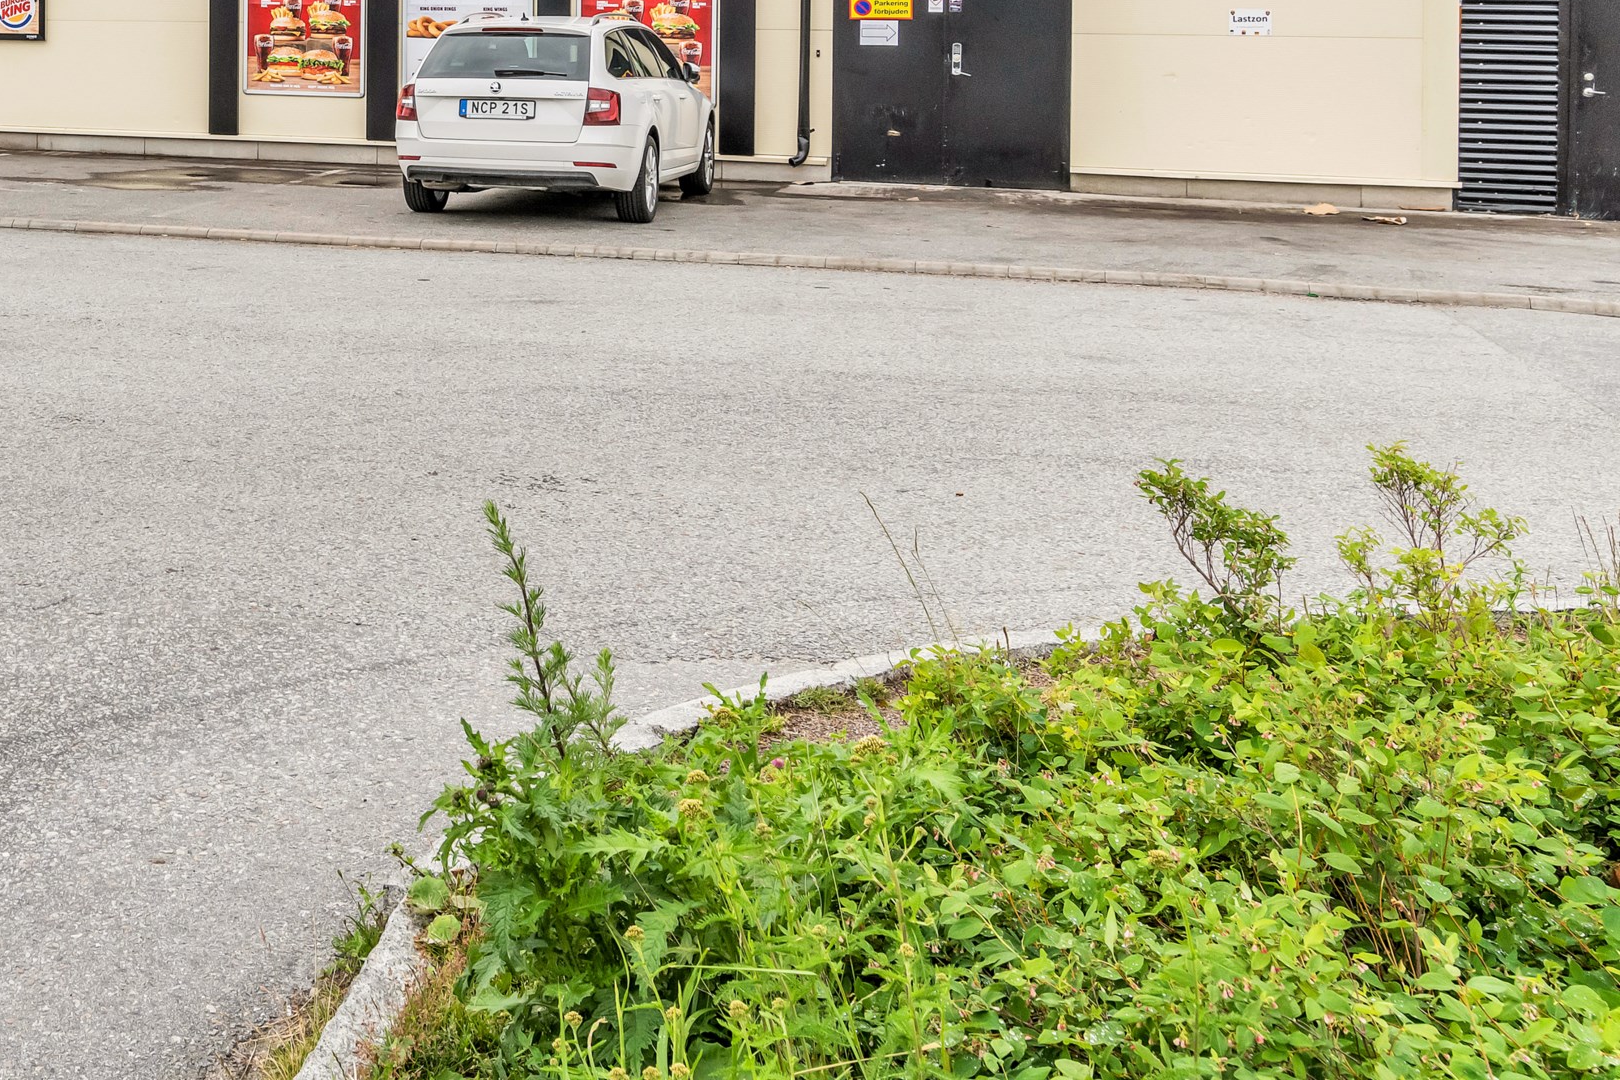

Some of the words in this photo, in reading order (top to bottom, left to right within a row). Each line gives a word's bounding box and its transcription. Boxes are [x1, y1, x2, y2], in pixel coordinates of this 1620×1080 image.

[874, 0, 908, 8] Parkering
[1, 1, 30, 19] KING
[1232, 15, 1268, 23] Lastzon
[471, 101, 497, 114] NCP
[502, 102, 529, 115] 21S
